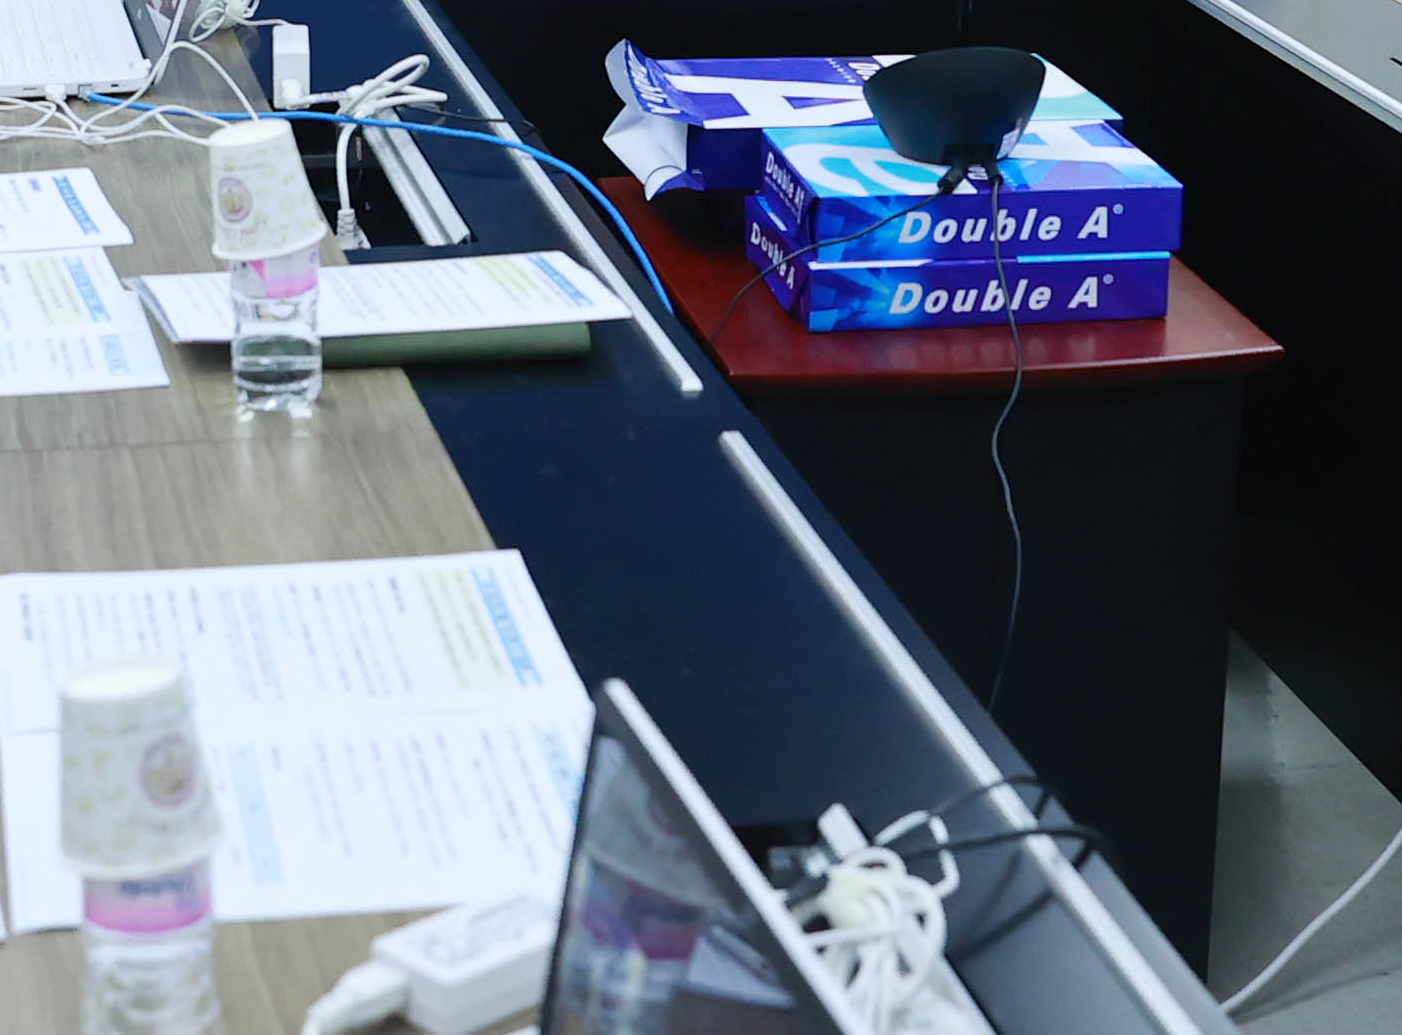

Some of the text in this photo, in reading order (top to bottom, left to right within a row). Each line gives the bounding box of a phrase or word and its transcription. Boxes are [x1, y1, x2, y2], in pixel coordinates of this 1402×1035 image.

[898, 205, 1109, 243] Double A
[750, 222, 787, 276] Double
[888, 276, 1099, 314] Double A
